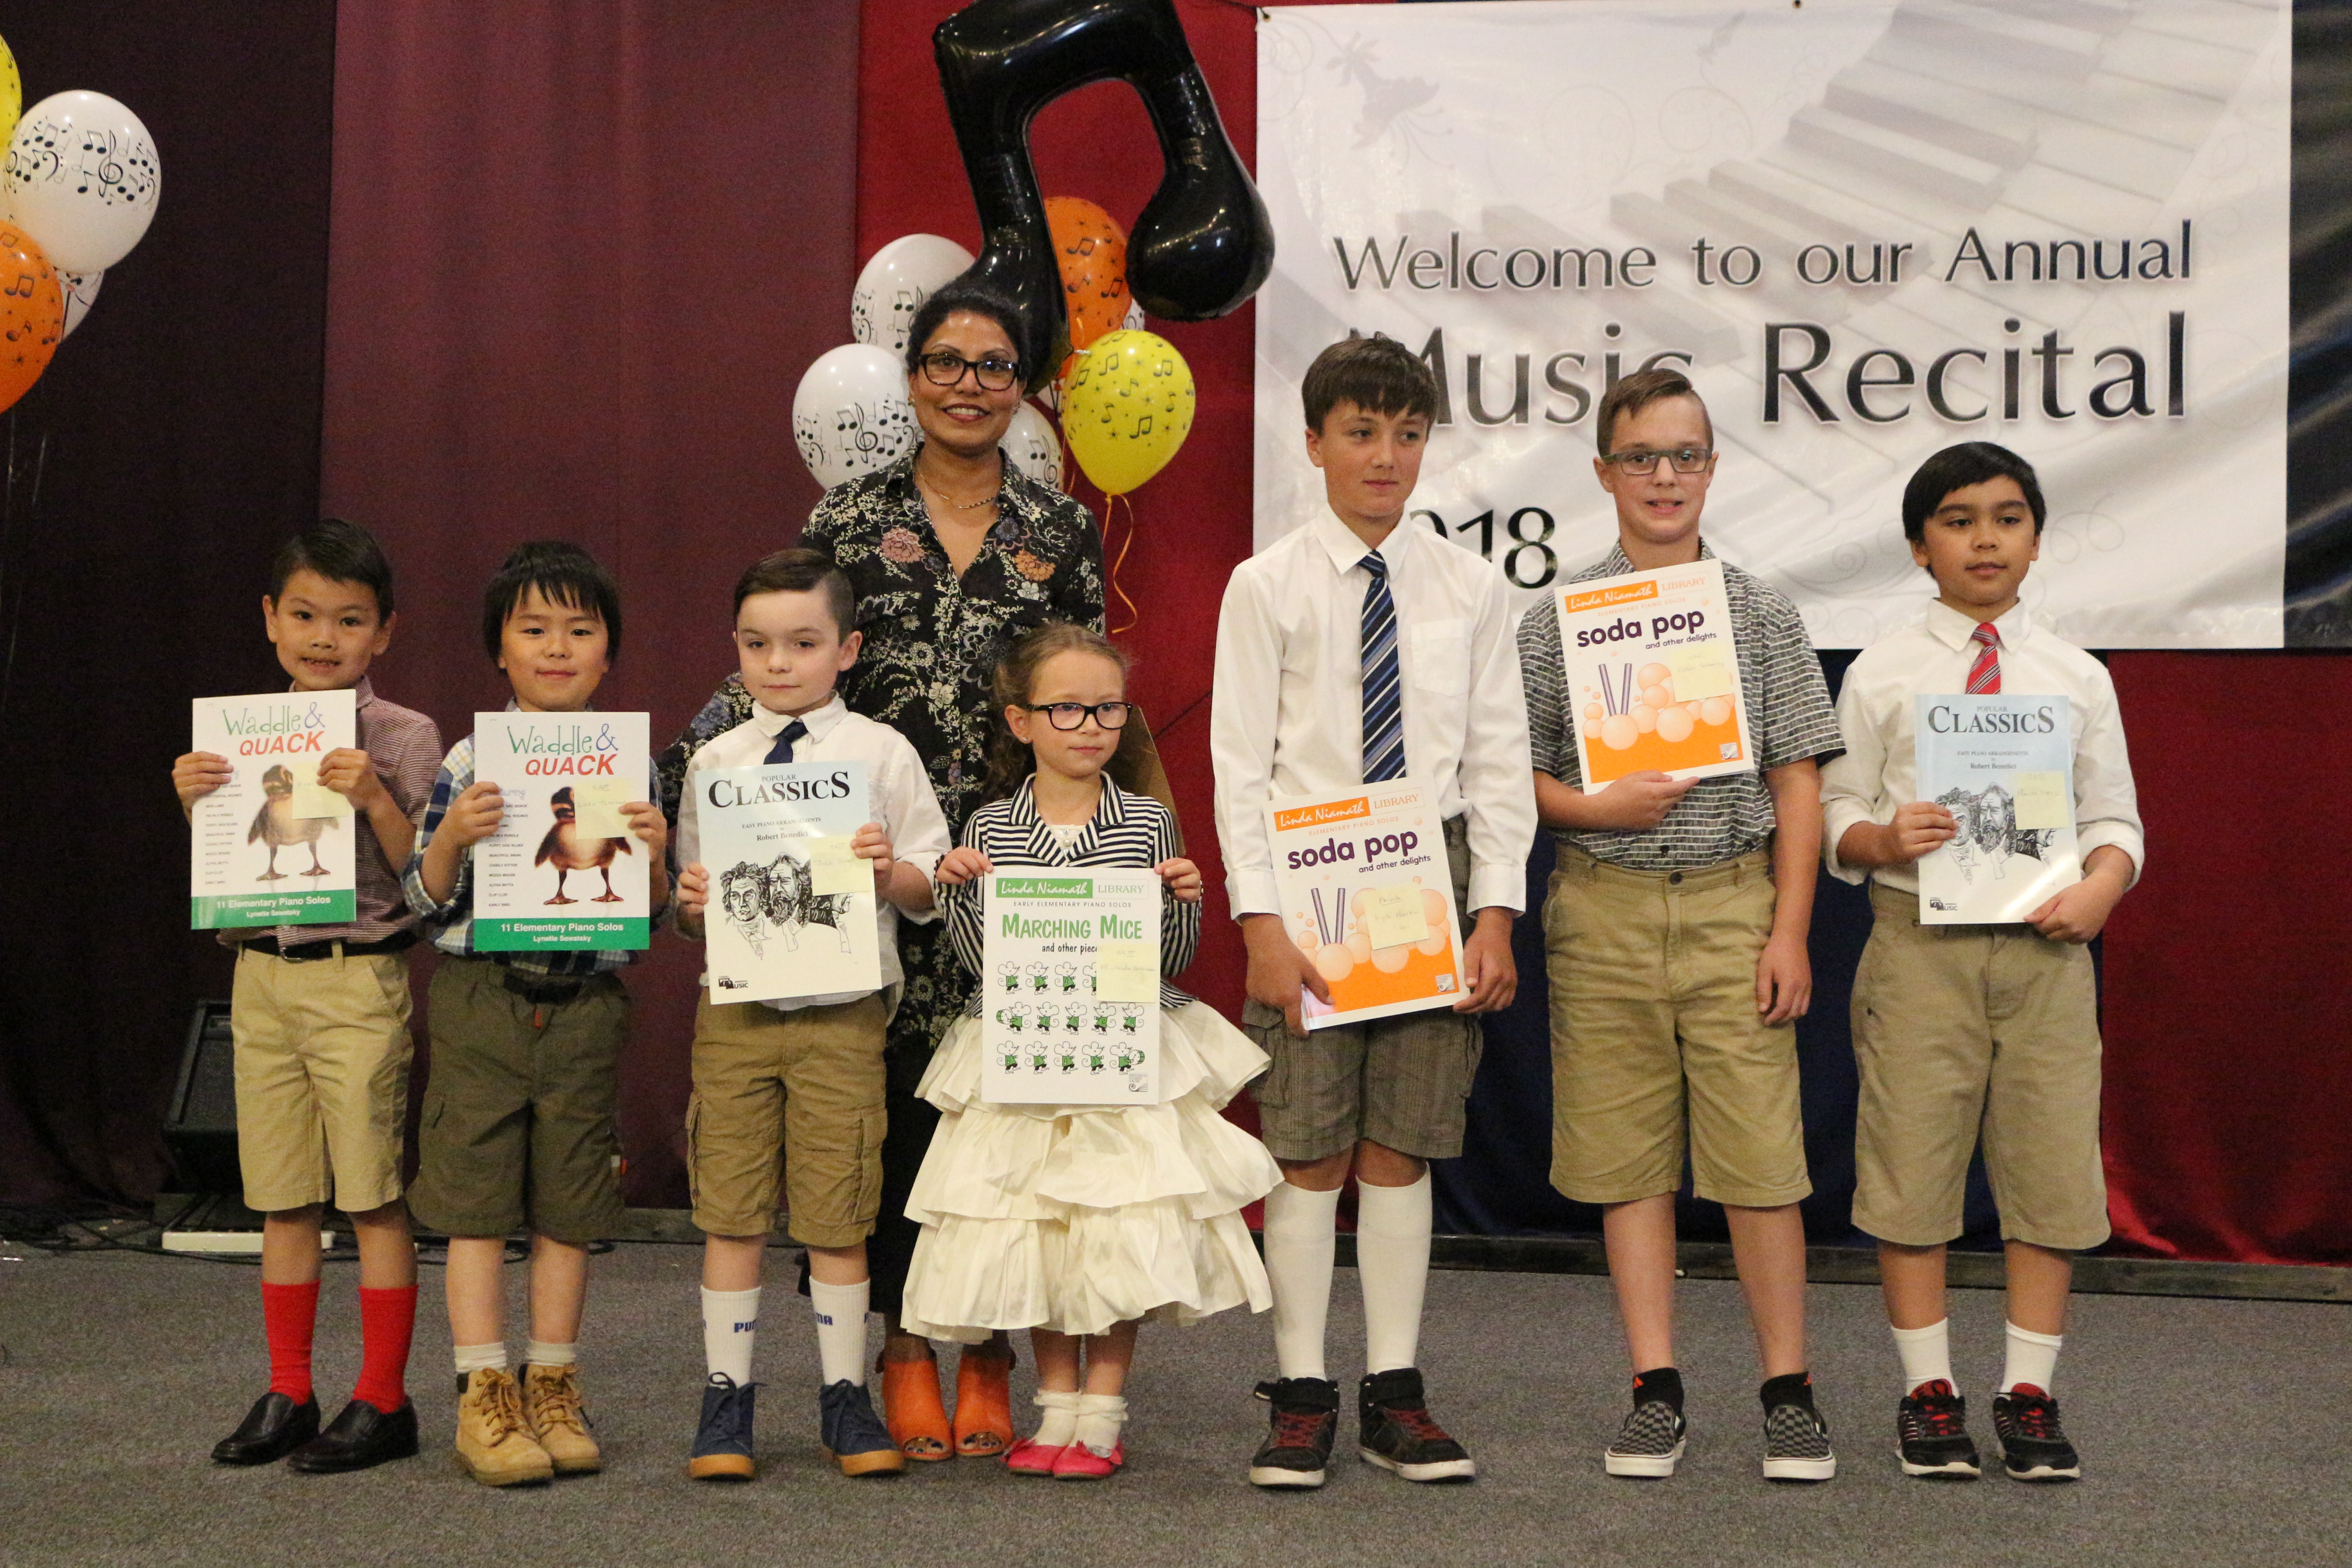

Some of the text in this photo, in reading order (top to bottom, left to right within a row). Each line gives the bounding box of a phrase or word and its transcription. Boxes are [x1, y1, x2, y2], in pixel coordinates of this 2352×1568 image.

[1334, 219, 2191, 290] Welcome to our Annual
[1349, 310, 2185, 425] usi Recital
[1570, 577, 1705, 609] Linda Niamath LIBRARY
[1577, 611, 1704, 647] soda pop
[1646, 632, 1717, 649] and other delights
[223, 702, 326, 735] Waddle &
[1928, 706, 2054, 733] CLASSICS
[240, 731, 324, 756] QUACK
[507, 724, 618, 755] Waddle &
[525, 754, 617, 775] QUACK
[709, 771, 850, 808] CLASSICS
[1280, 794, 1418, 827] Linda Niamath LIBRARY
[1309, 825, 1350, 836] ELEMENTARY
[1288, 831, 1417, 869] soda pop
[1359, 854, 1431, 873] and other delights
[1001, 881, 1034, 894] Linda
[1037, 882, 1088, 895] Niamath
[229, 899, 277, 907] Elementary
[279, 897, 304, 906] Piano
[306, 896, 331, 904] Solos
[514, 923, 566, 933] Elementary
[568, 923, 594, 931] Piano
[597, 923, 623, 931] Solos
[1002, 913, 1142, 939] MARCHING MICE
[1042, 942, 1097, 955] and other piec
